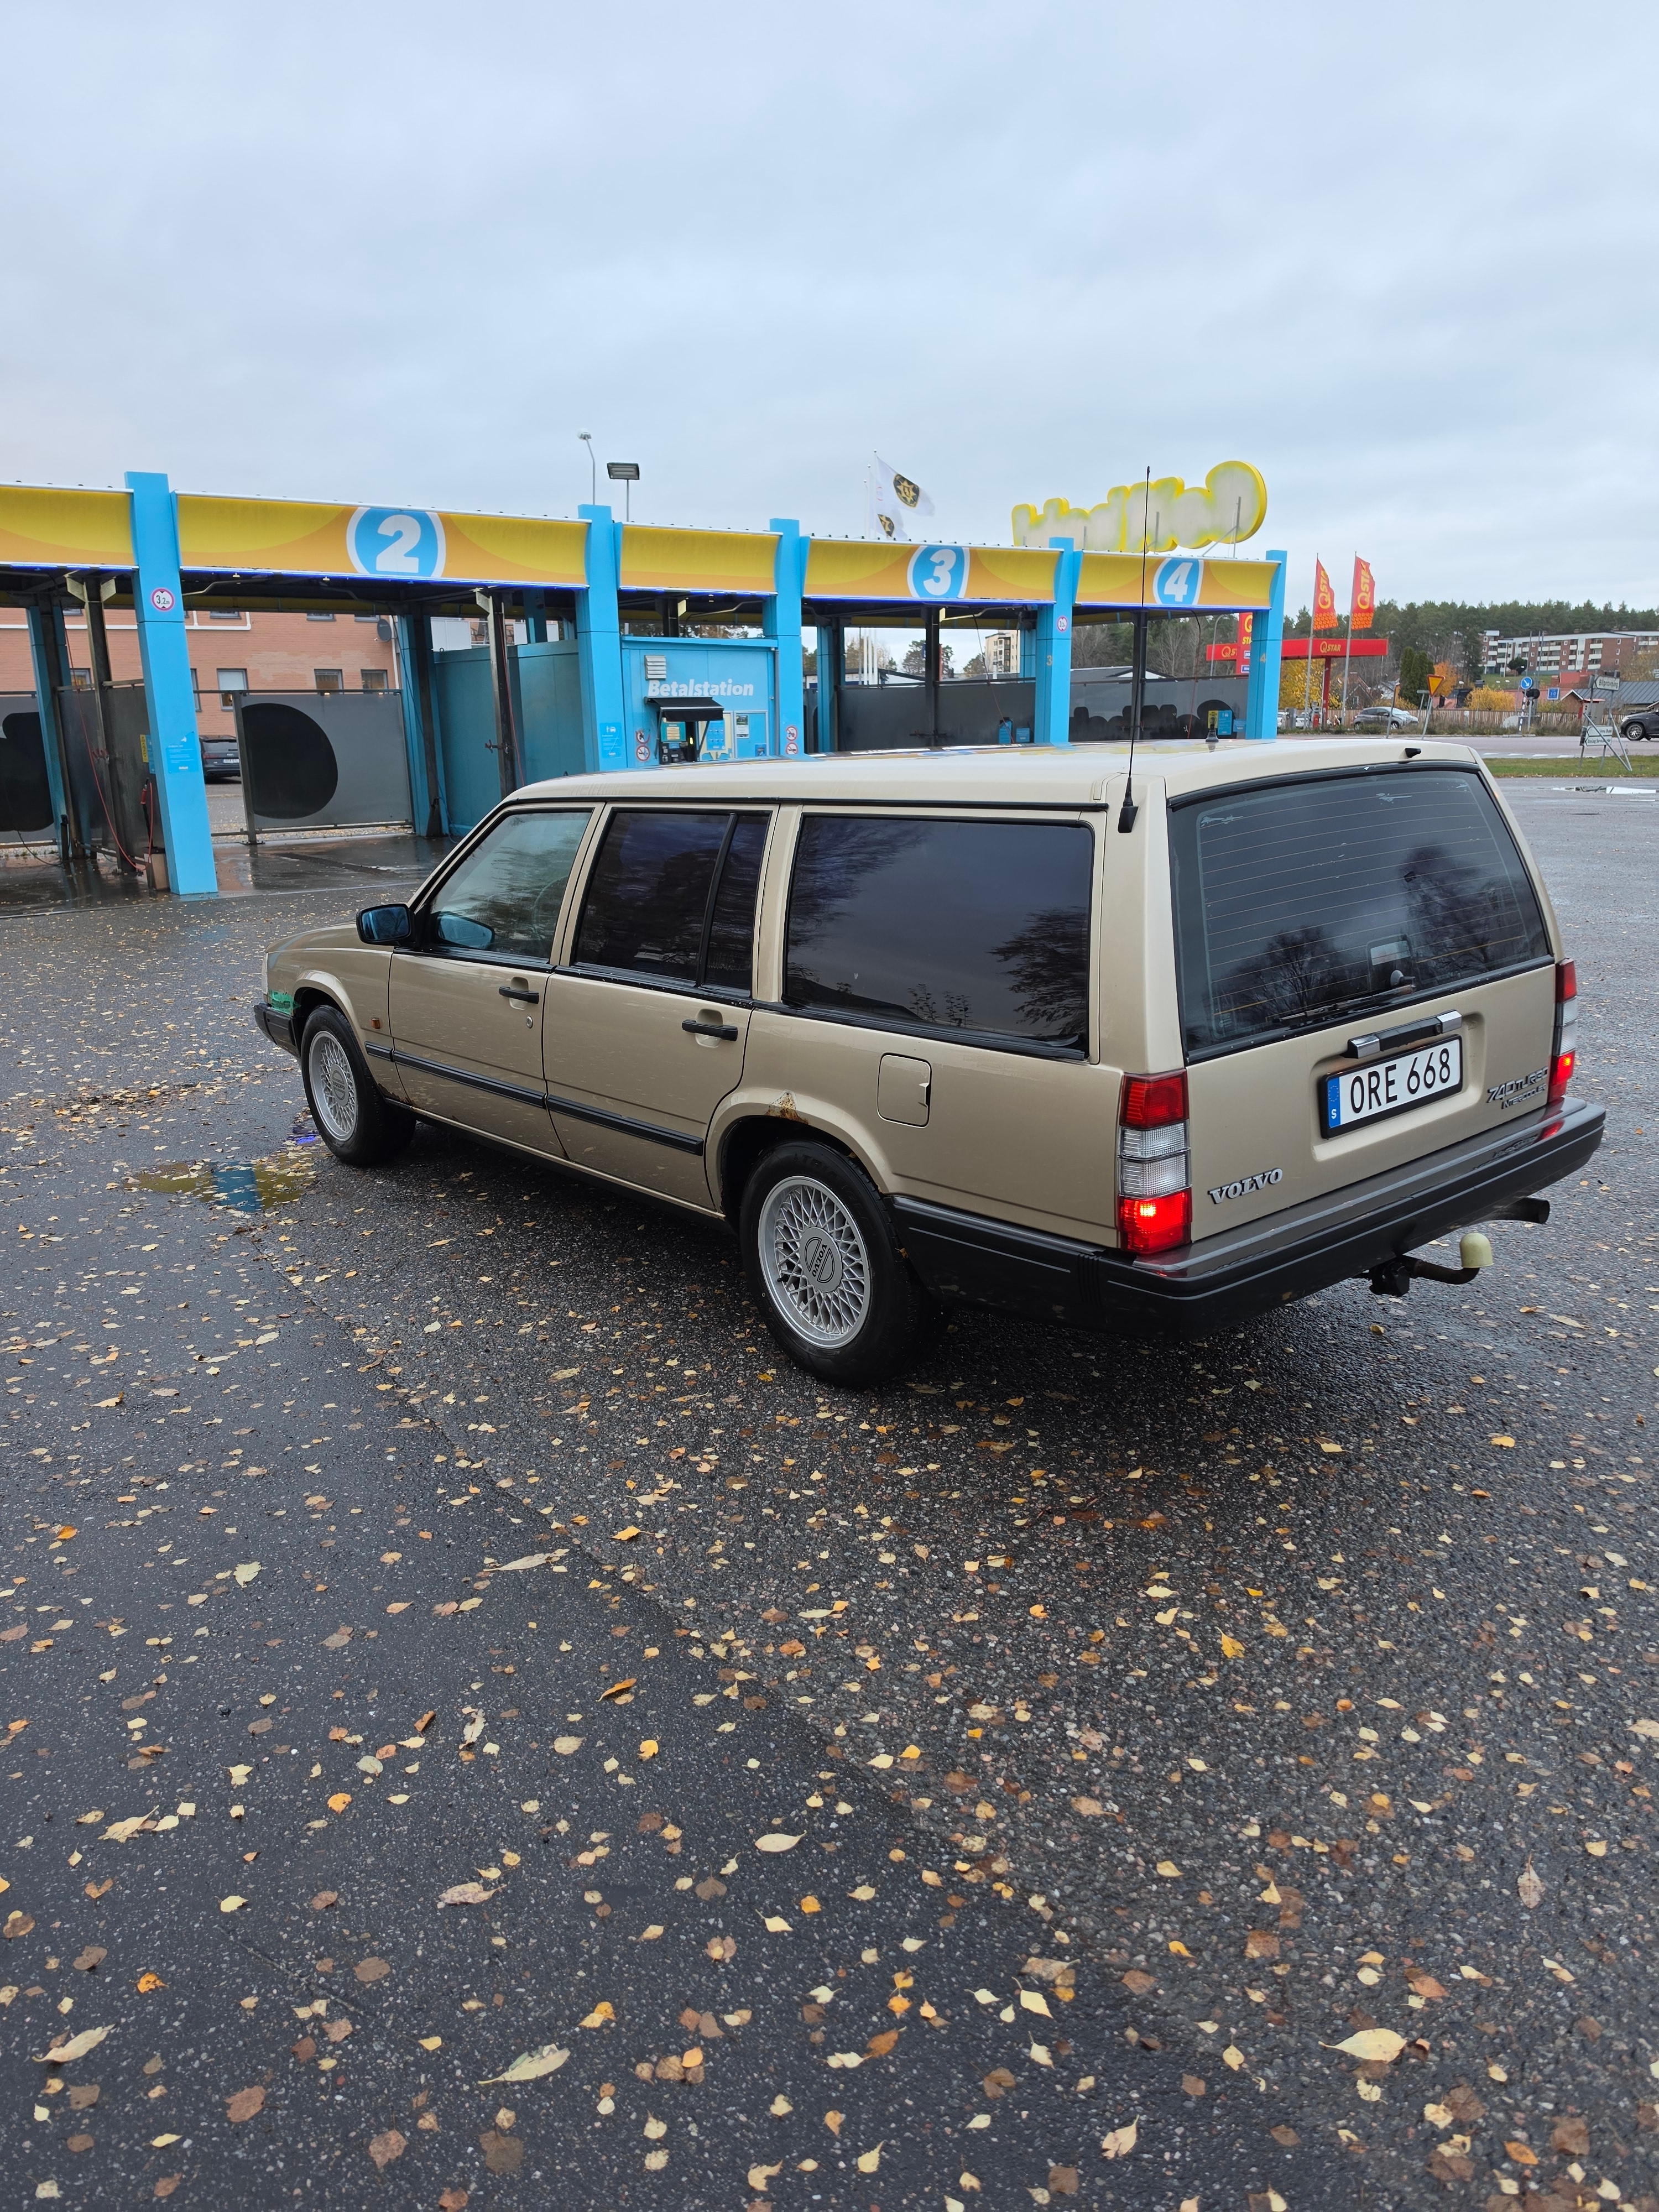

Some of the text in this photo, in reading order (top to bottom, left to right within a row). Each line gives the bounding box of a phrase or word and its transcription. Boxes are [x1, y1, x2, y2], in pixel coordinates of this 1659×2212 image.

[375, 514, 421, 573] 2
[923, 549, 956, 596] 3
[1164, 562, 1193, 602] 4
[1046, 655, 1052, 666] 3
[1260, 653, 1266, 663] 4
[648, 679, 754, 697] Betalstation
[332, 1080, 345, 1090] VOLVO
[1350, 1048, 1451, 1114] ORE 668
[1331, 1108, 1337, 1119] S
[1207, 1167, 1282, 1204] VOLVO
[812, 1244, 828, 1277] VOLVO
